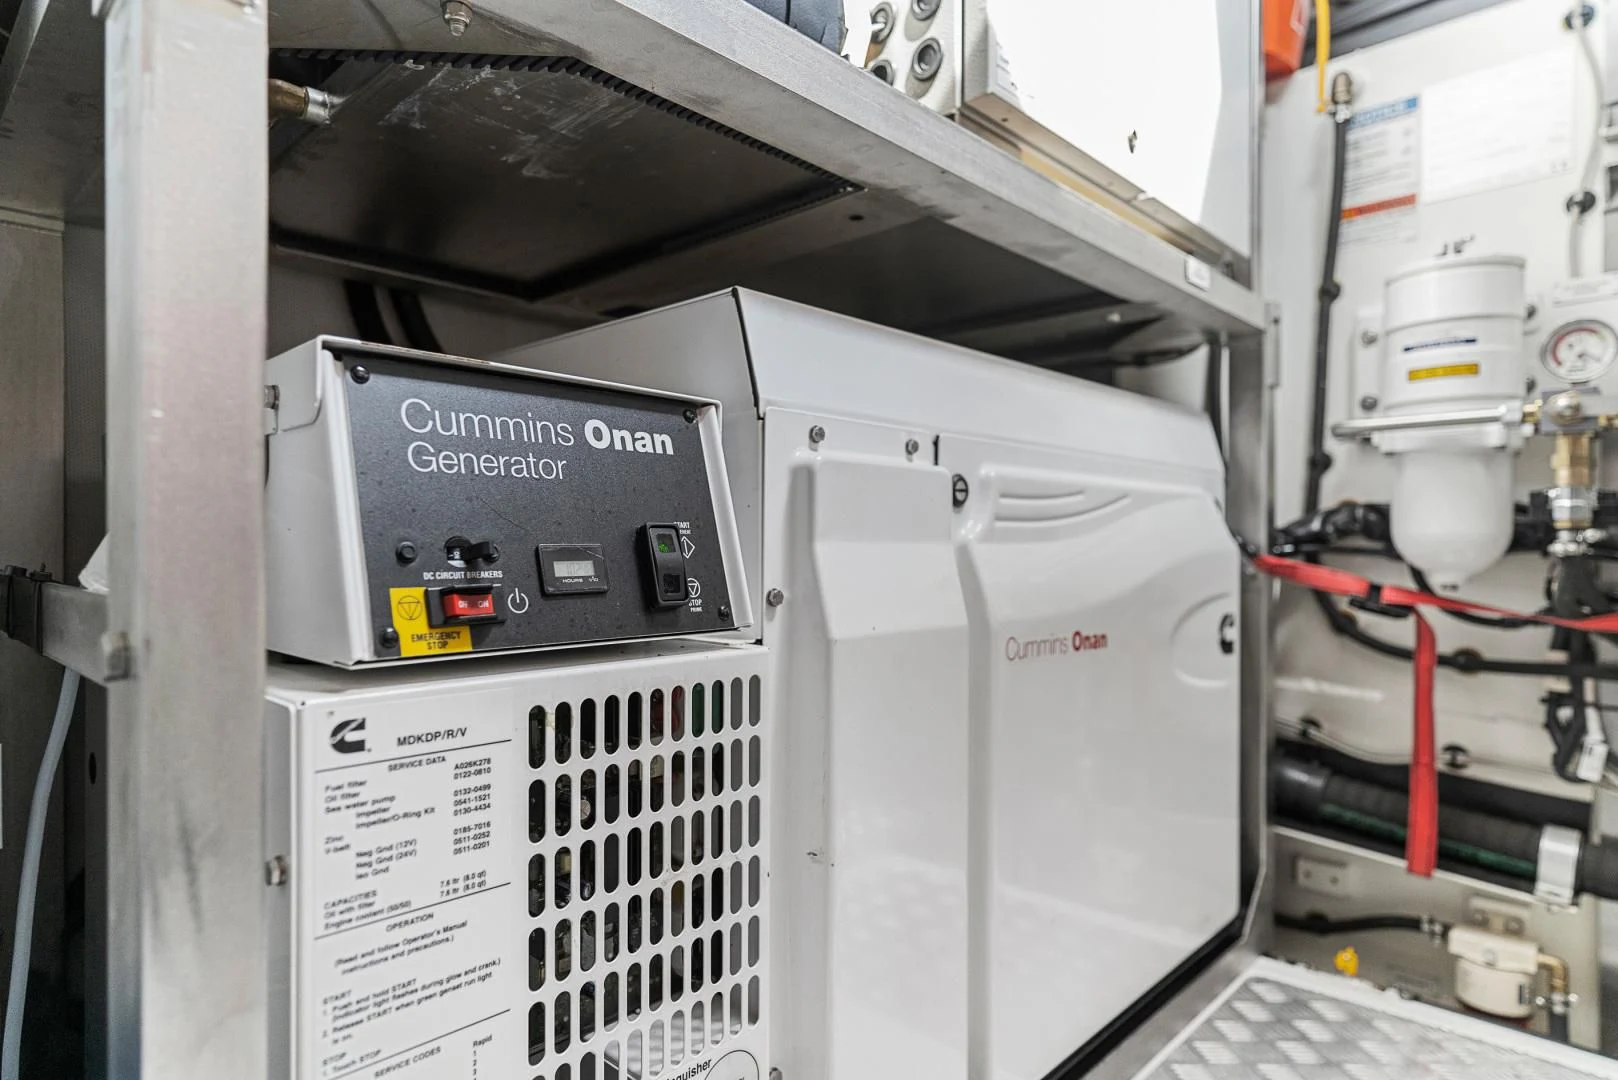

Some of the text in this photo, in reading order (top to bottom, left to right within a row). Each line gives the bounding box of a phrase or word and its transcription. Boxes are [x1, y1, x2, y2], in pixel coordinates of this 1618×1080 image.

[400, 398, 674, 456] Cummins Onan
[407, 441, 567, 480] Generator
[423, 570, 503, 581] DC CIRCUIT BREAKERS
[478, 599, 489, 608] ON
[411, 631, 462, 643] EMERGENCY
[427, 641, 449, 650] STOP
[1005, 631, 1108, 661] Cummins Onan
[397, 727, 468, 747] MDKDP/R/V
[388, 756, 447, 772] SERVICE DATA
[385, 912, 434, 932] OPERATION
[361, 949, 375, 959] and
[442, 920, 468, 933] Manual
[391, 950, 405, 960] and
[464, 967, 477, 976] and
[391, 978, 417, 993] START
[473, 1034, 493, 1048] Rapid
[374, 1046, 441, 1078] SERVICE CODES
